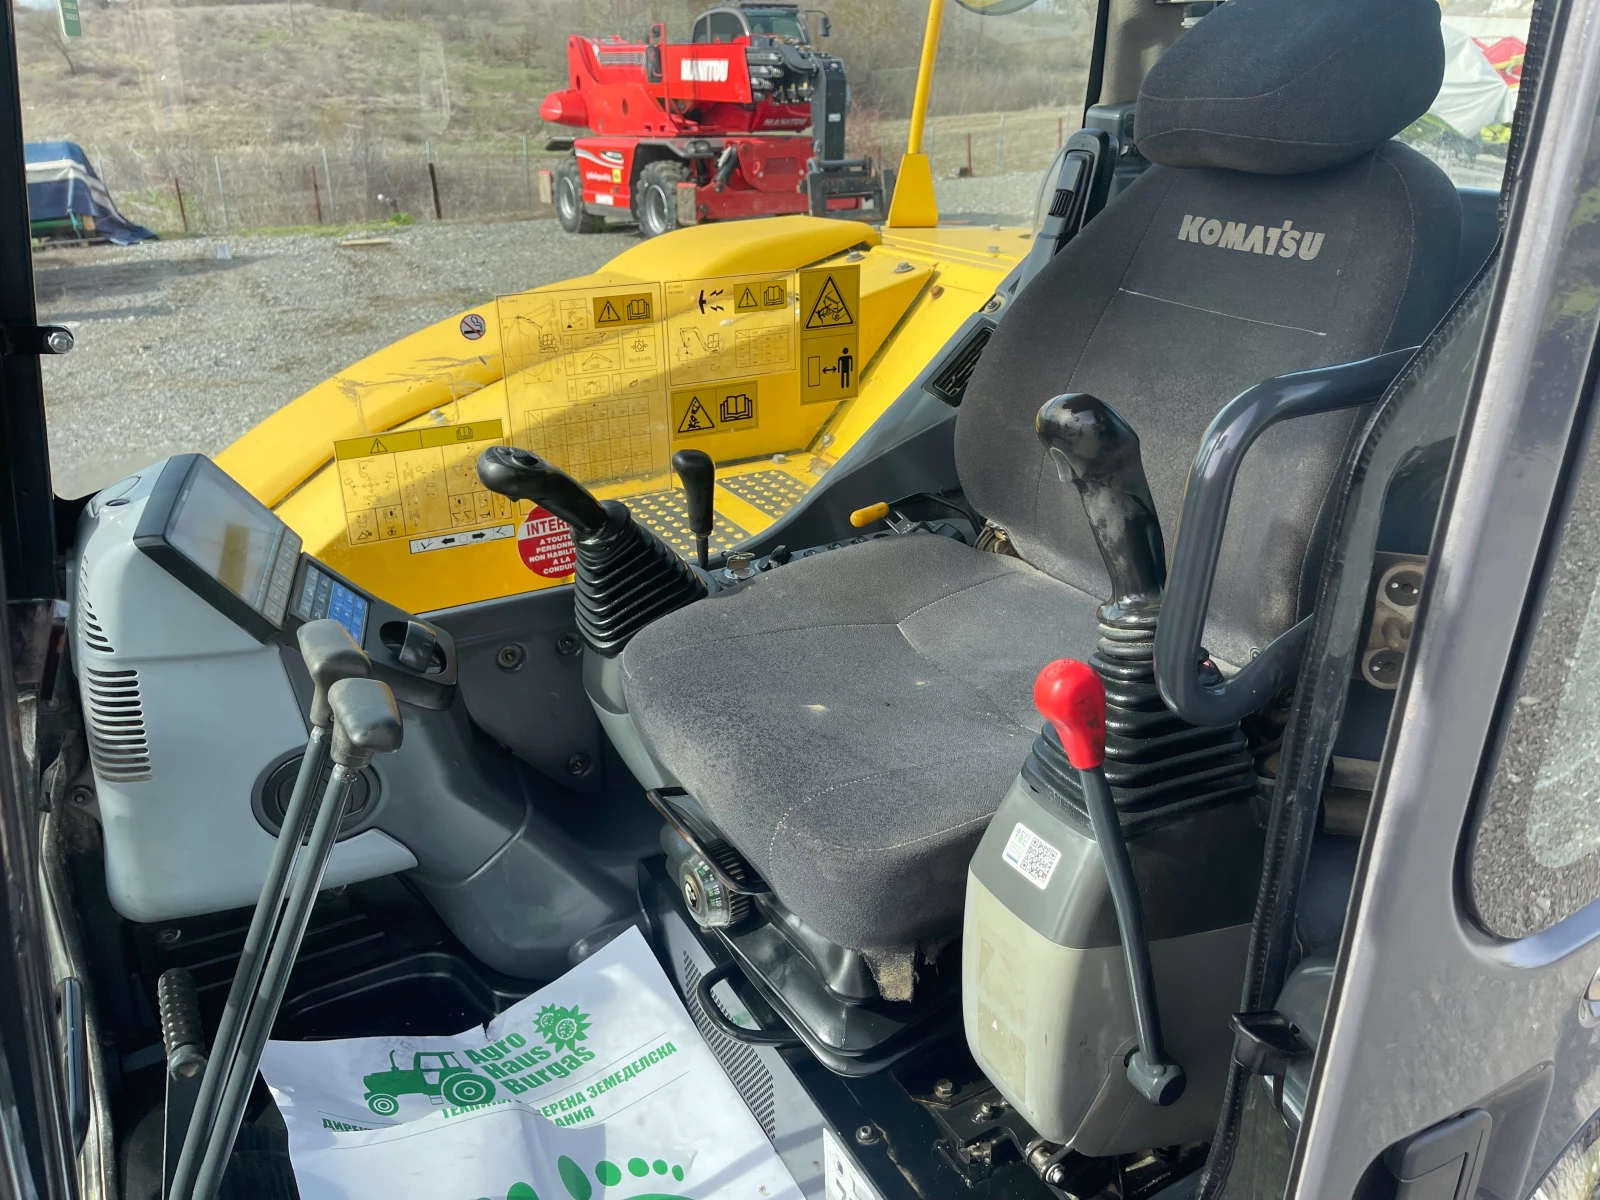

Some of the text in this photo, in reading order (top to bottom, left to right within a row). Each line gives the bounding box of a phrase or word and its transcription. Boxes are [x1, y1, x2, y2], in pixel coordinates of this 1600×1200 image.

[681, 59, 729, 83] MANITOU
[1177, 214, 1325, 261] KOMATSU
[529, 553, 546, 563] NON
[536, 541, 576, 554] PERSONN
[560, 556, 571, 564] LA
[463, 1032, 527, 1065] Agro
[480, 1045, 552, 1080] Haus
[500, 1046, 596, 1095] Burgas
[586, 1041, 677, 1099] ЗЕМЕДЕЛСКА
